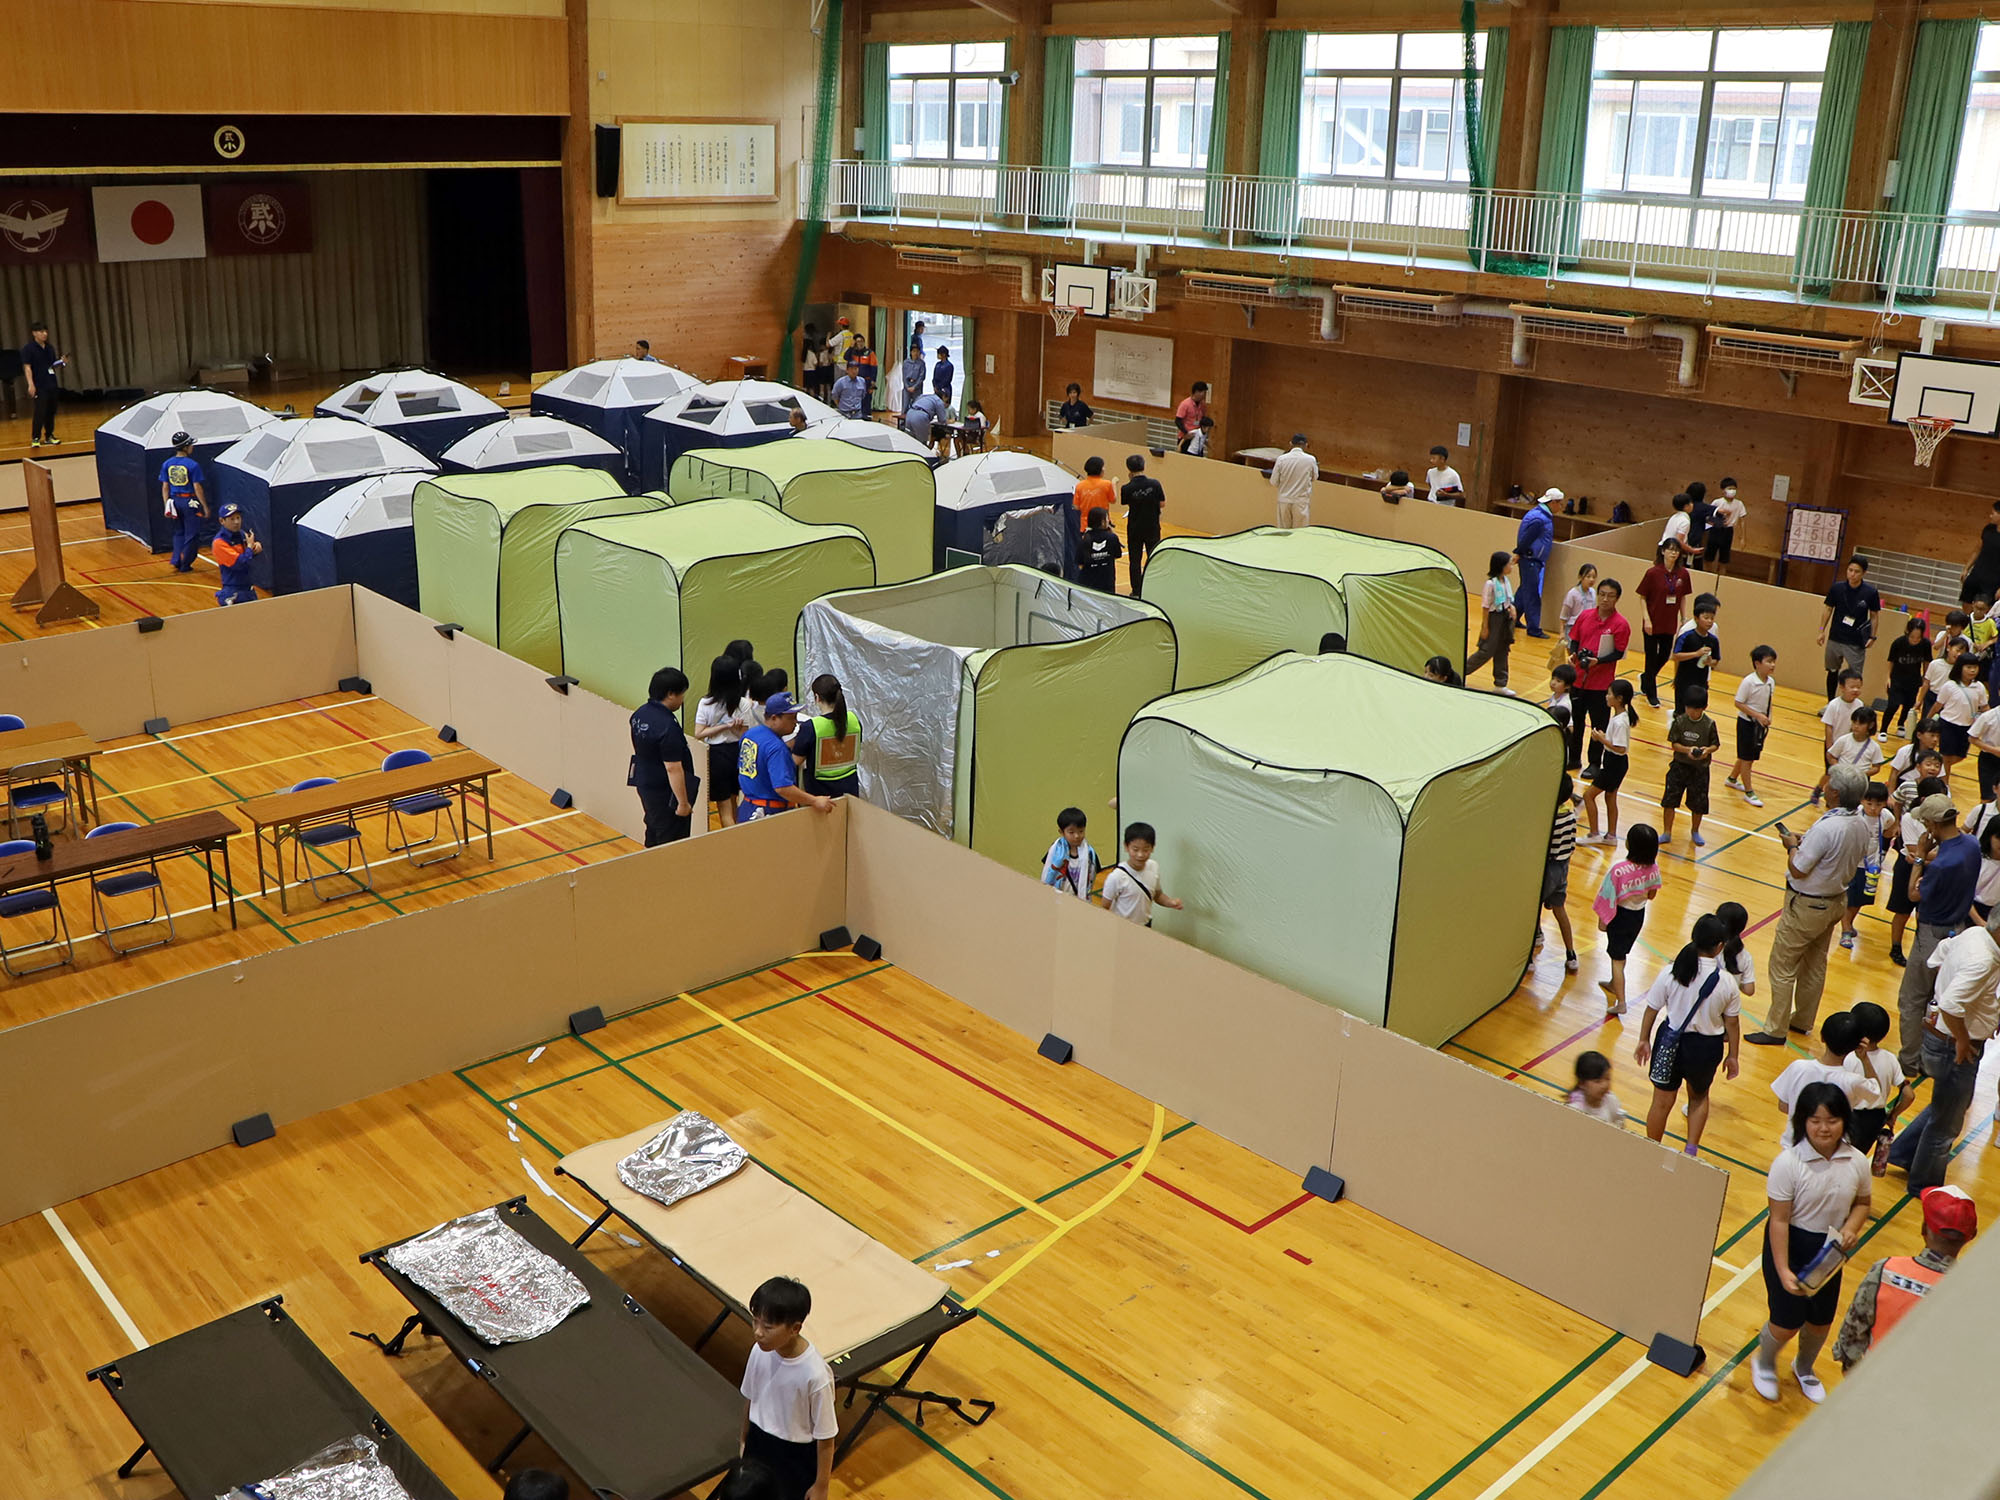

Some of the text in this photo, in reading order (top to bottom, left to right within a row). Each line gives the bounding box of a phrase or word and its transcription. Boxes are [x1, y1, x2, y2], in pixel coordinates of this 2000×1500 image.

[1797, 512, 1836, 527] 1 2 3
[1794, 527, 1834, 542] 4 5 6
[1792, 542, 1832, 558] 7 8 9
